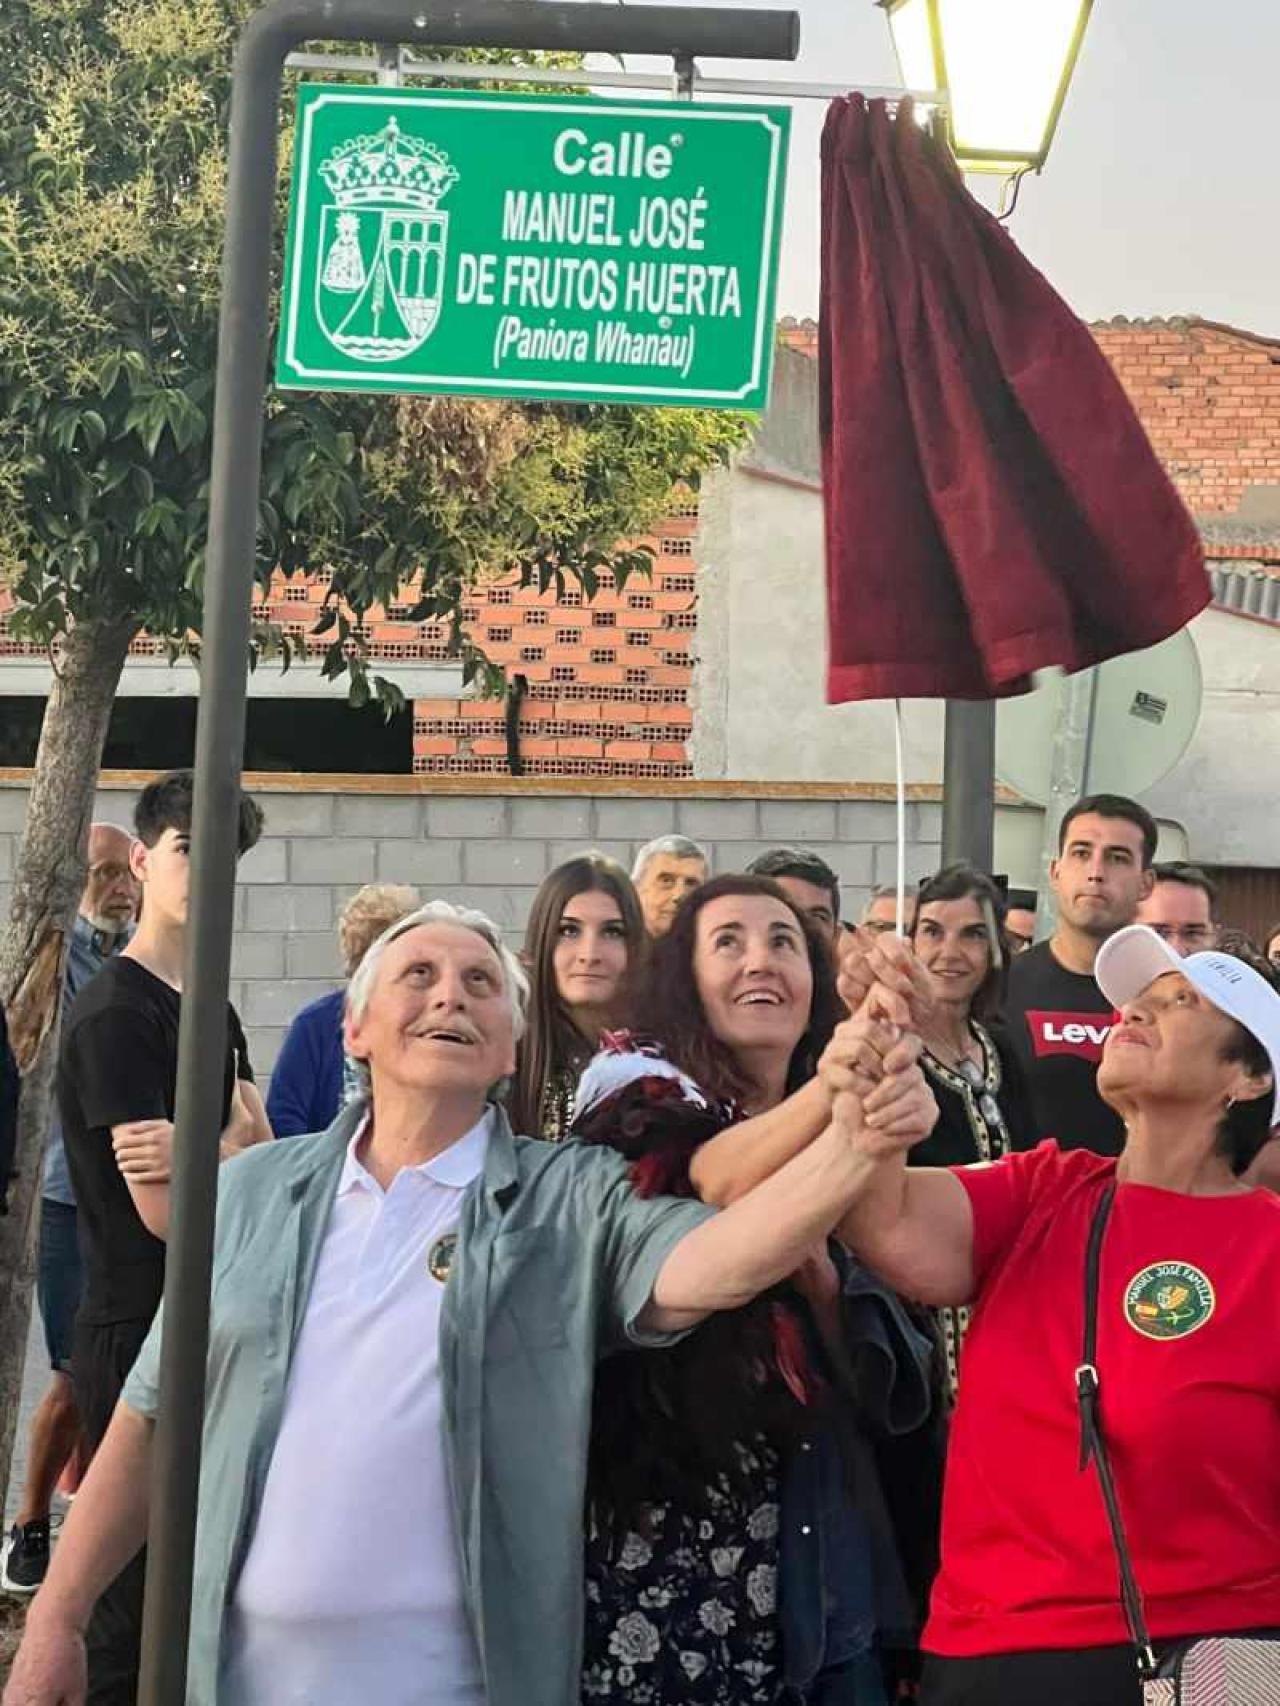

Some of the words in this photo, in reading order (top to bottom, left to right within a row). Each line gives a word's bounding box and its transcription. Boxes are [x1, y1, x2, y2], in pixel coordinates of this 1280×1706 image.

[554, 128, 673, 179] Calle
[502, 190, 622, 246] MANUEL
[629, 187, 708, 250] JOSÉ
[456, 253, 497, 305] DE
[502, 255, 619, 311] FRUTOS
[625, 262, 741, 318] HUERTA
[493, 315, 589, 368] (Paniora
[1042, 1022, 1110, 1045] Lev
